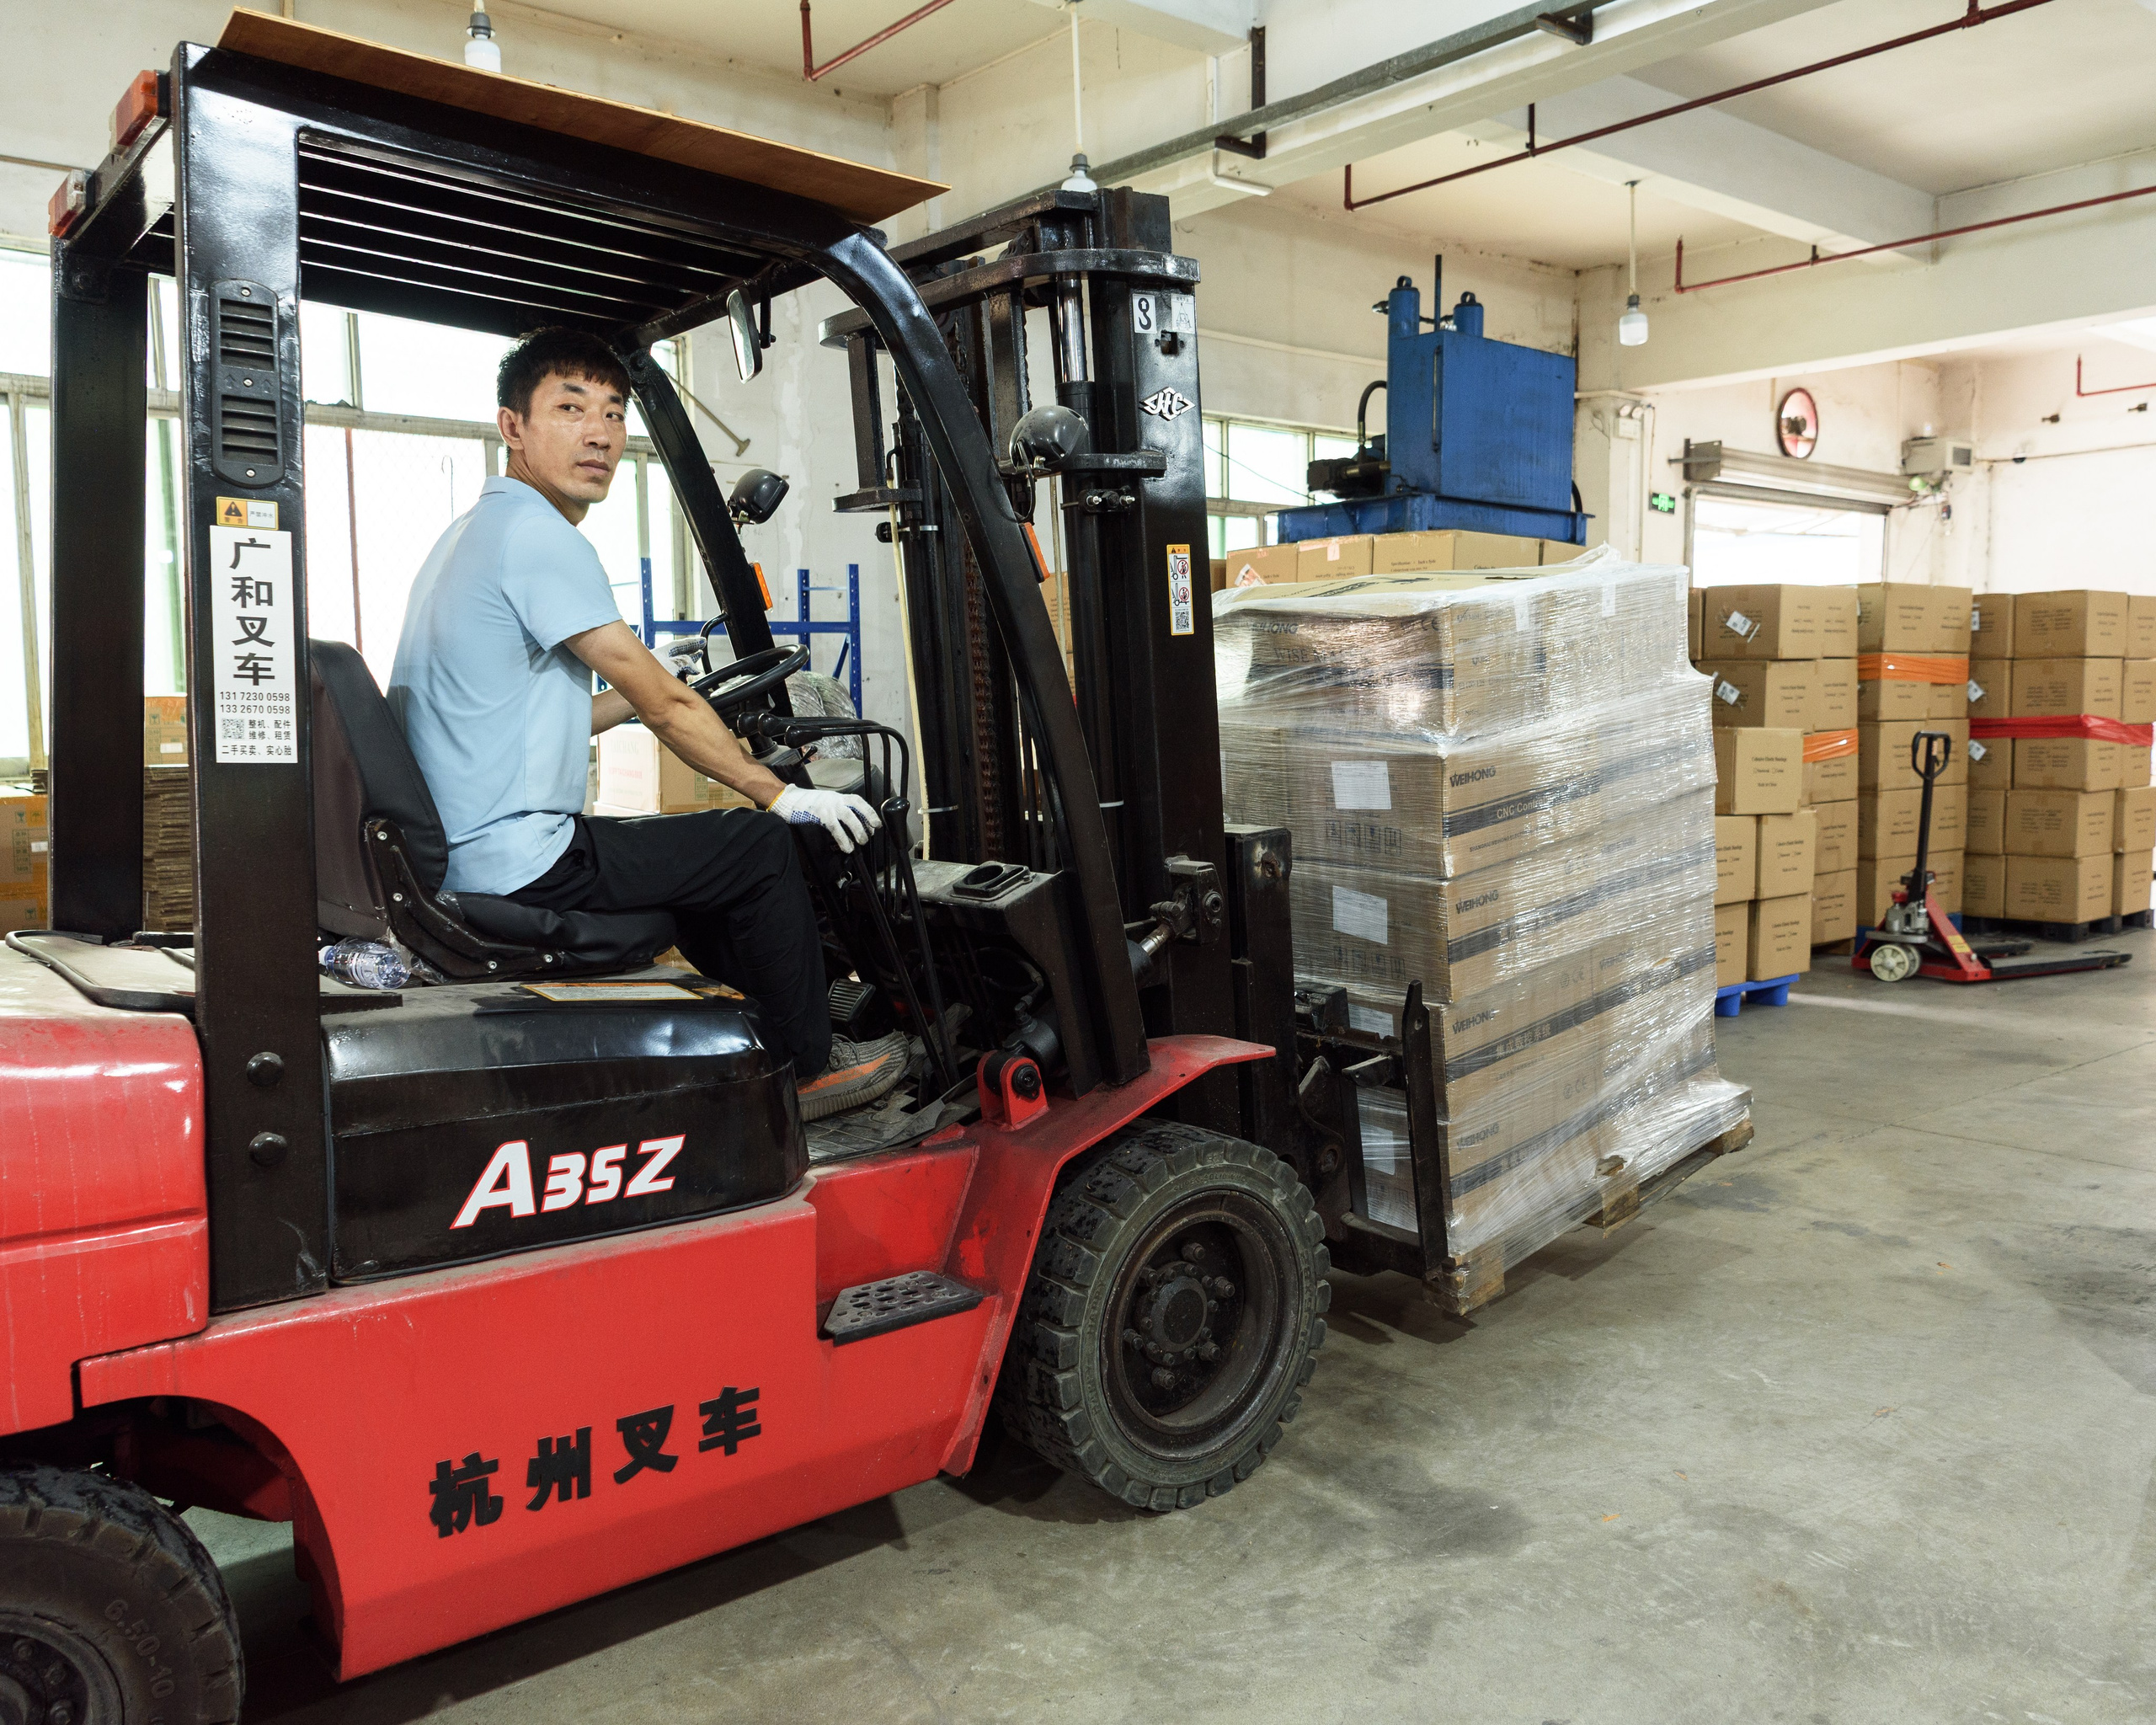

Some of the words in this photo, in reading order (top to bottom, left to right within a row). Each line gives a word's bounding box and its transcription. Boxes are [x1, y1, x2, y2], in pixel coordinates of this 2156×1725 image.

[229, 537, 275, 686] 广和叉车
[220, 692, 237, 700] 131
[240, 692, 264, 701] 7230
[266, 692, 290, 701] 0598
[220, 704, 237, 713] 133
[240, 705, 264, 713] 2670
[267, 705, 291, 713] 0598
[221, 745, 291, 756] 二手买卖、实心胎
[1449, 766, 1497, 788] WEIHONG
[1497, 805, 1515, 819] CNC
[1455, 889, 1499, 914] WEIHONG
[1452, 1008, 1497, 1034] WEIHONG
[429, 1385, 762, 1540] 杭州叉车
